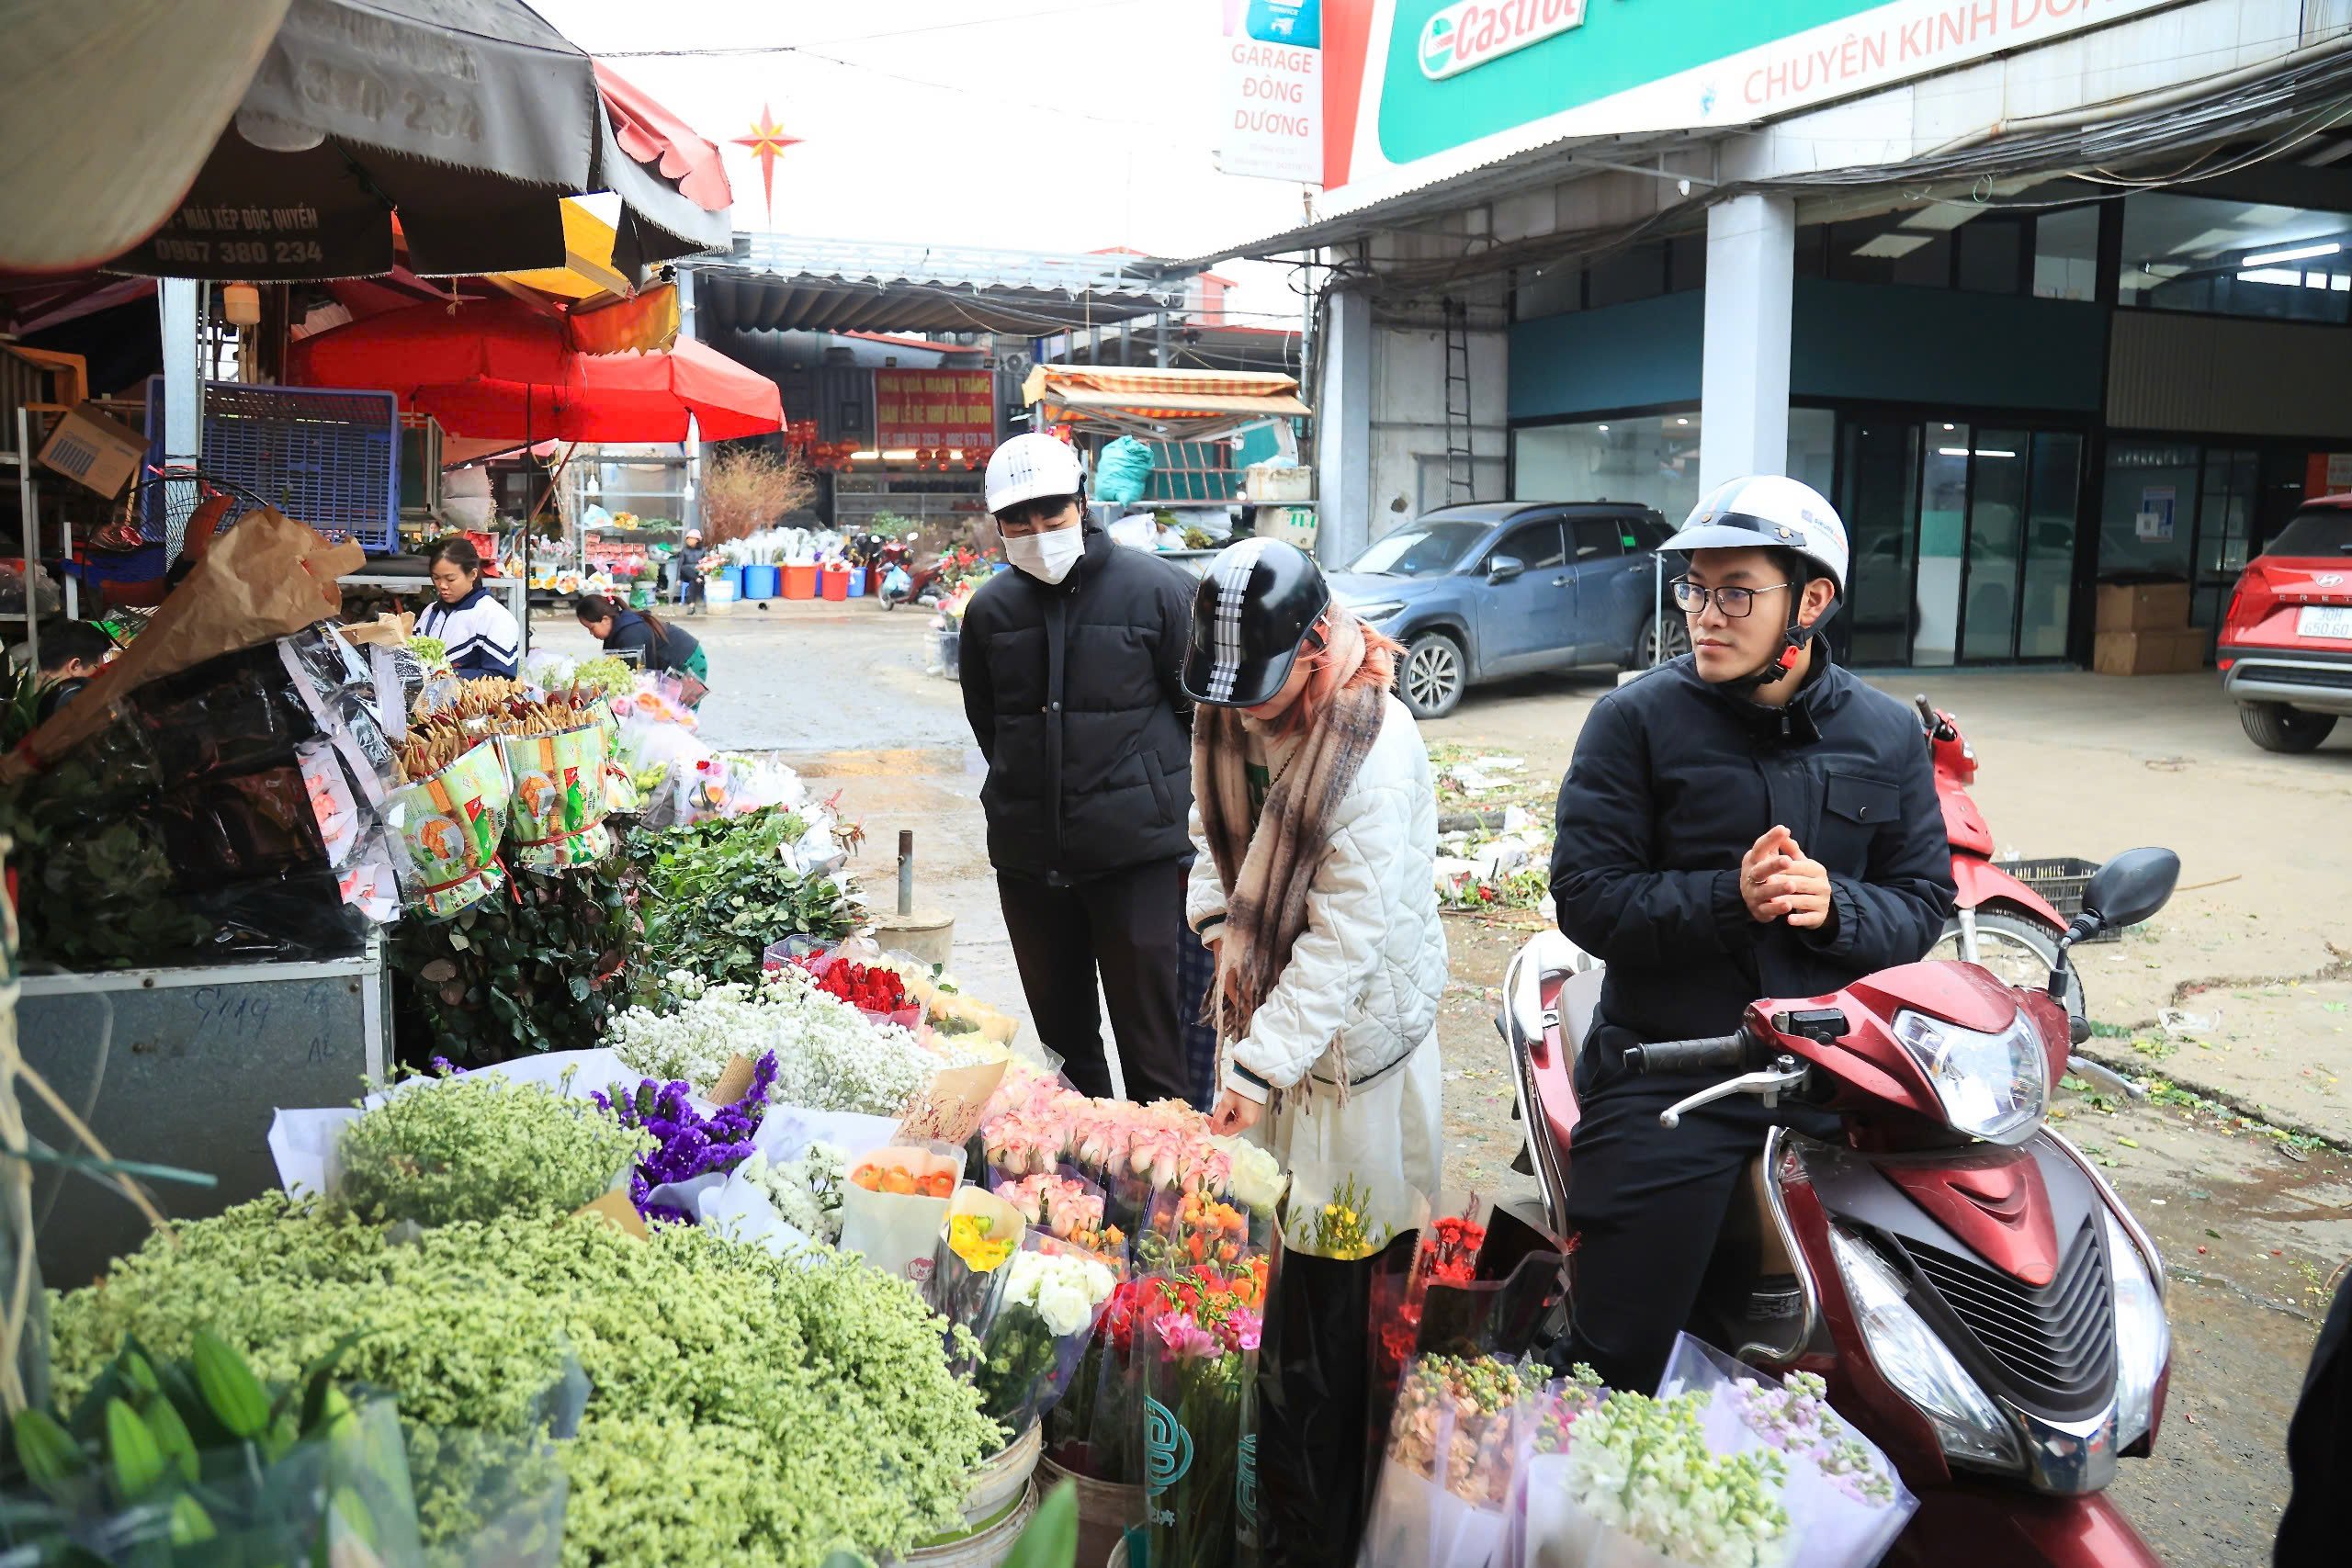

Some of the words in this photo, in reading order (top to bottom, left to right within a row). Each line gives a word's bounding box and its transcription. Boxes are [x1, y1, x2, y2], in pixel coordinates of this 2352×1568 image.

[1455, 0, 1577, 61] Castro
[1231, 43, 1313, 73] GARAGE
[1743, 30, 1887, 104] CHUYÊN
[1899, 0, 2000, 62] KINH
[1242, 73, 1303, 104] ĐÔNG
[1235, 108, 1309, 137] DƯƠNG
[220, 241, 268, 264] 380
[275, 240, 323, 264] 234
